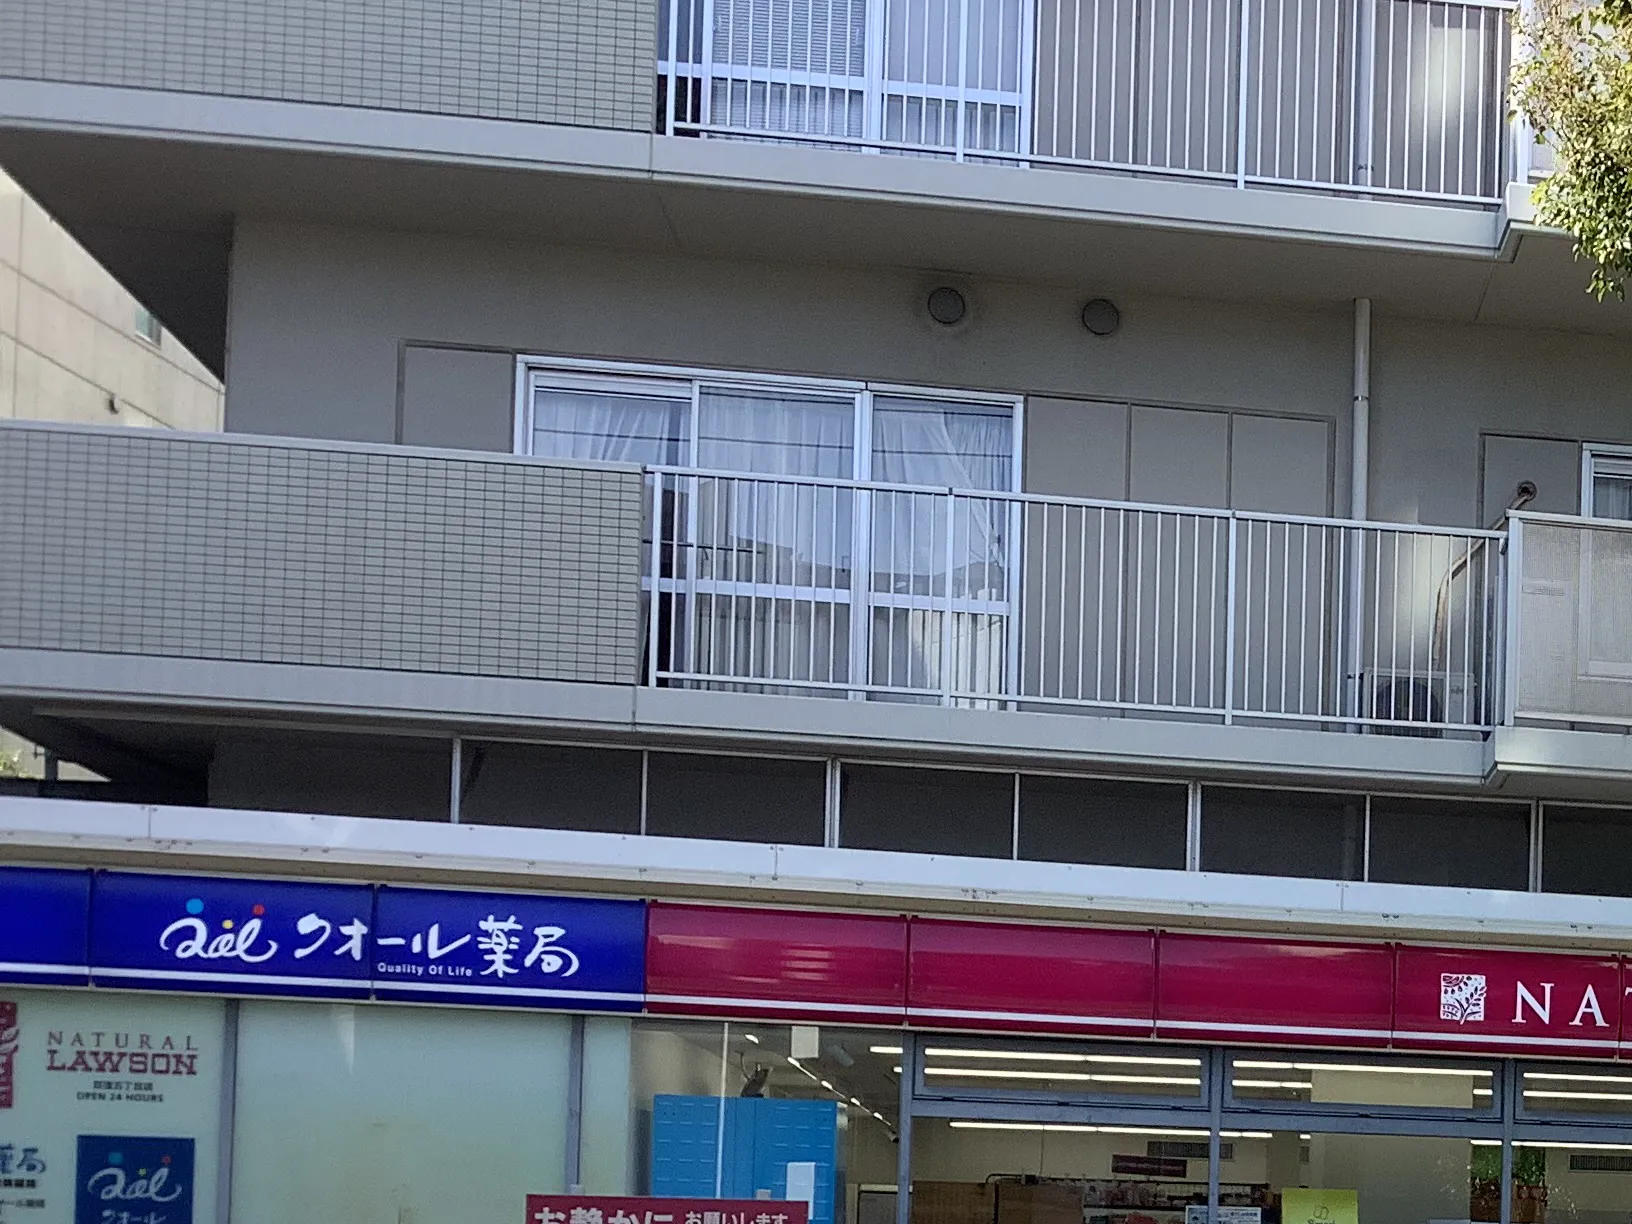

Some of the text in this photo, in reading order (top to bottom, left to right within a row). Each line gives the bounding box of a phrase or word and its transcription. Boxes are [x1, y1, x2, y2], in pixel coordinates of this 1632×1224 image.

[294, 912, 580, 979] クオール薬局
[377, 962, 473, 977] Quality Of Life
[47, 1030, 199, 1051] NATURAL
[47, 1049, 198, 1076] LAWSON
[77, 1091, 106, 1101] OPEN
